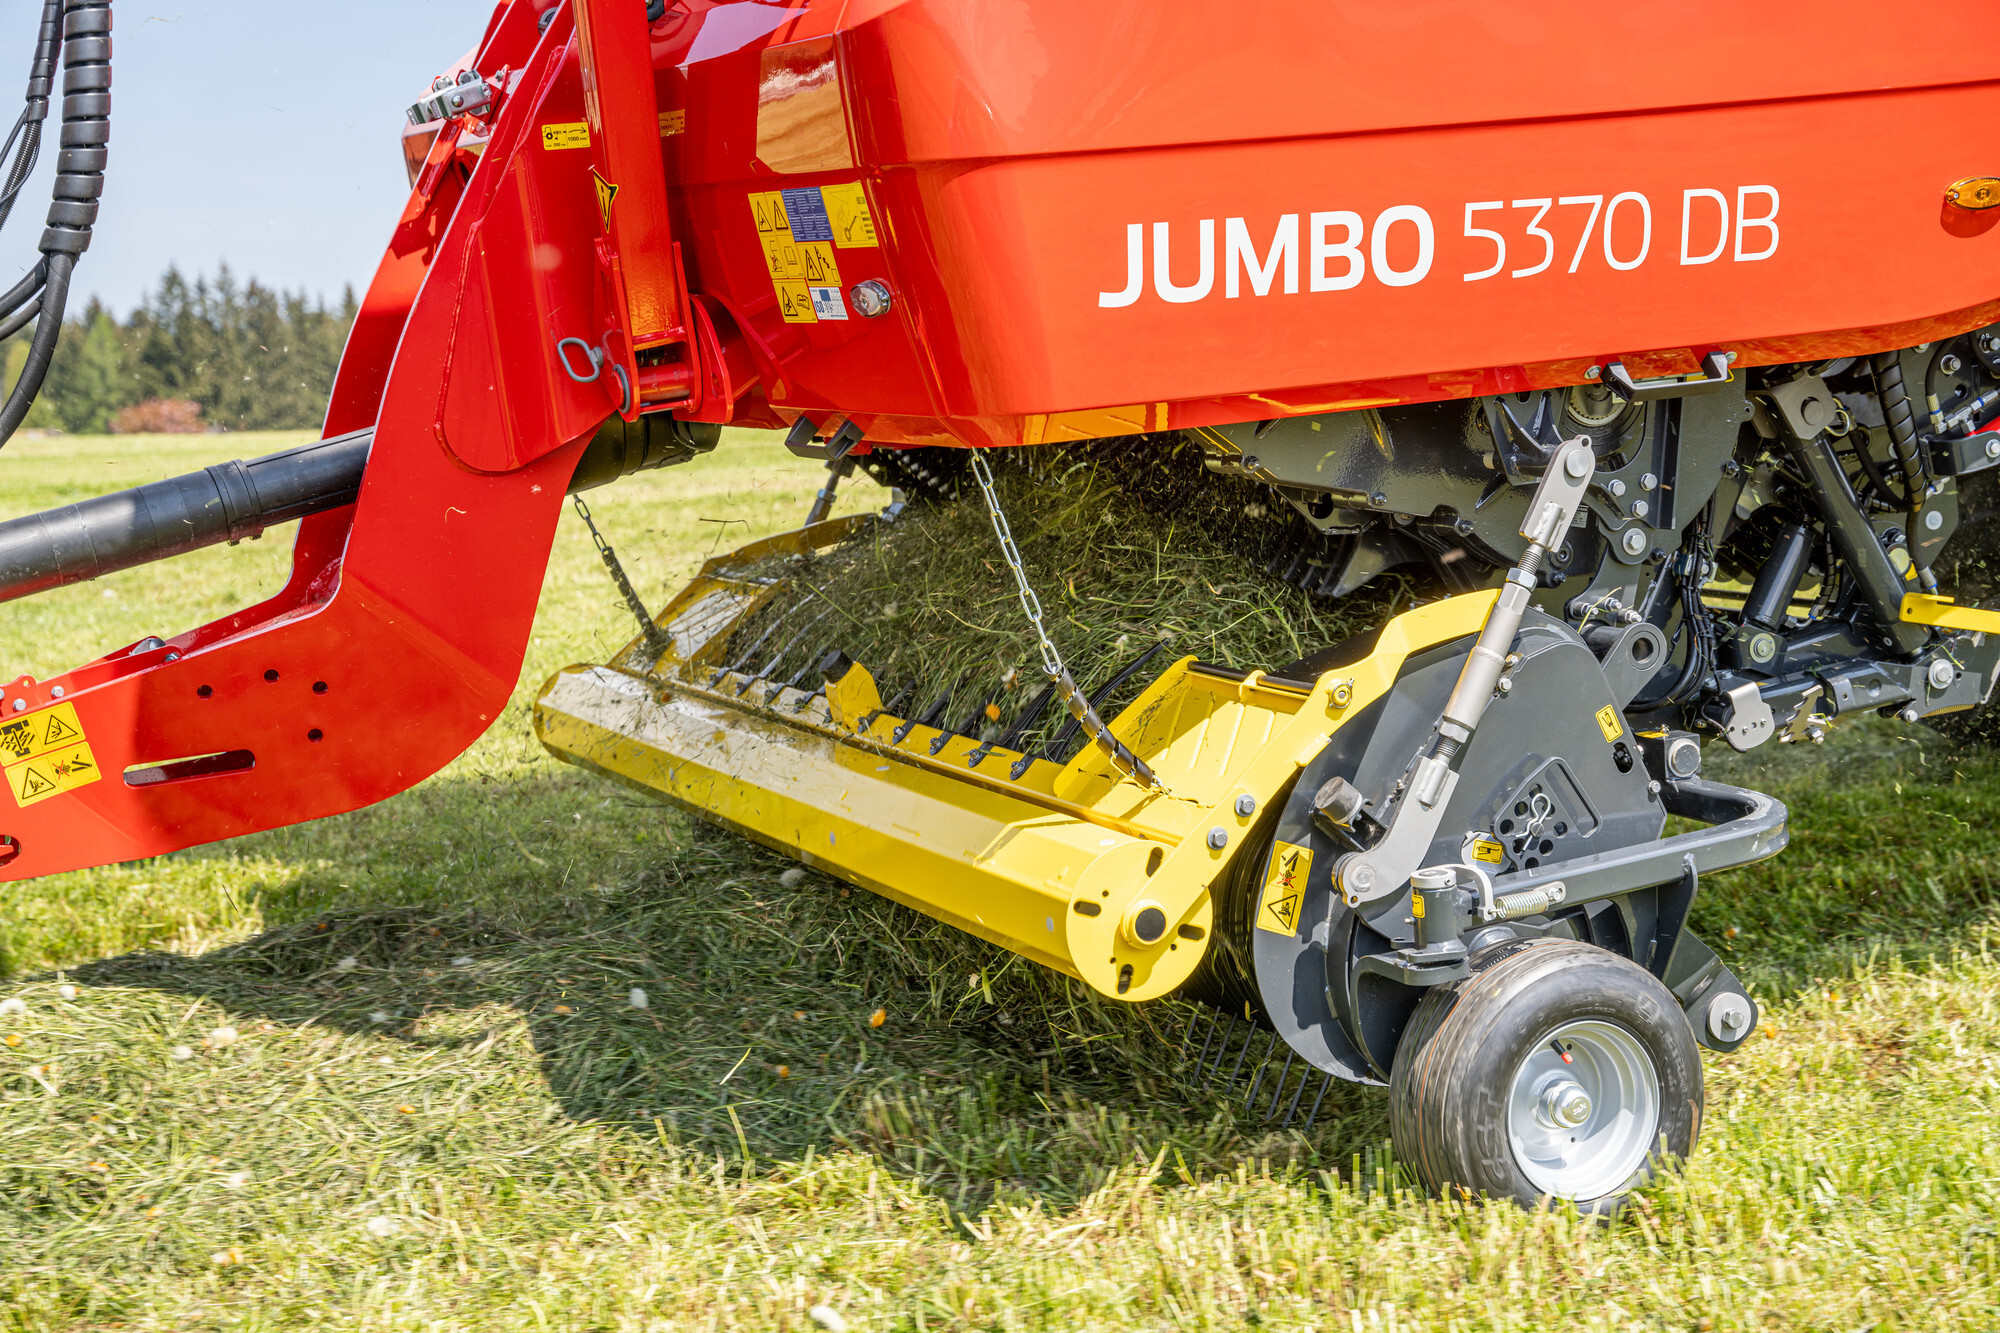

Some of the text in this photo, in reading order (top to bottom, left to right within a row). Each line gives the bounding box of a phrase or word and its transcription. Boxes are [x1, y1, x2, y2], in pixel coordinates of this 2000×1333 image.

[1098, 184, 1780, 308] JUMBO 5370 DB
